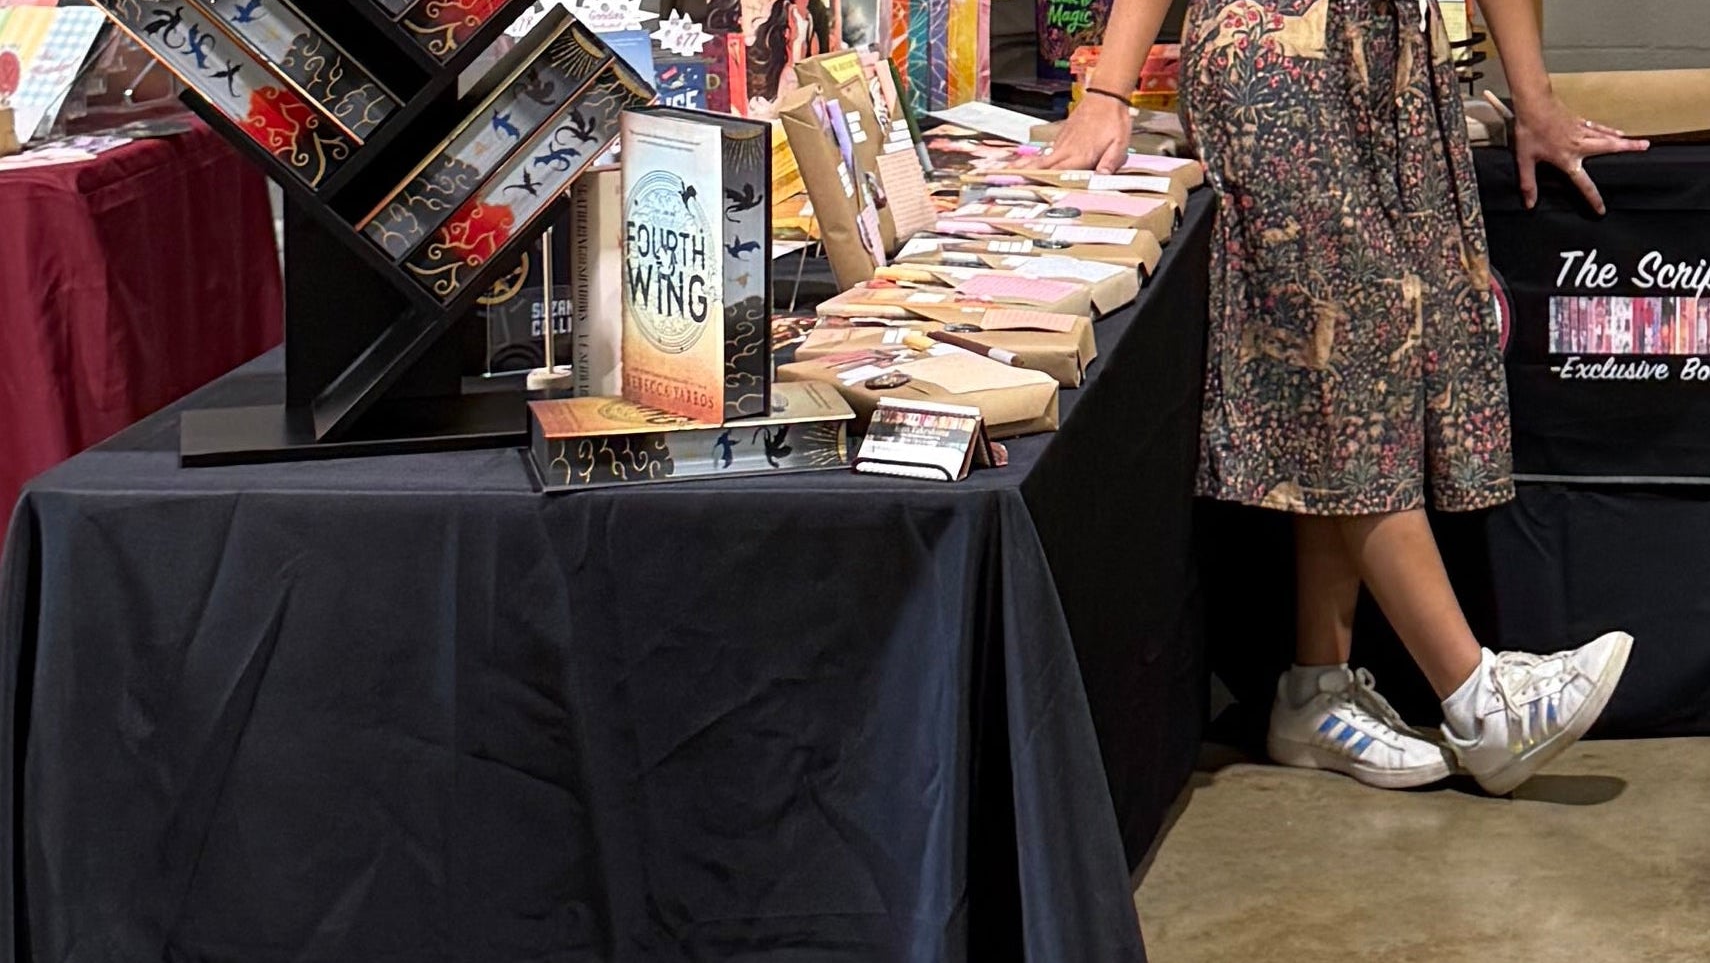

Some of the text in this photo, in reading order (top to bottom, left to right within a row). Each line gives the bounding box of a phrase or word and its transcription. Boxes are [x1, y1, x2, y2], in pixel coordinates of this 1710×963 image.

[1047, 5, 1094, 33] Magic
[676, 32, 700, 47] $77
[626, 221, 706, 271] FOURTH
[1555, 250, 1619, 289] The
[626, 260, 708, 323] WING
[1550, 357, 1669, 381] -Exclusive
